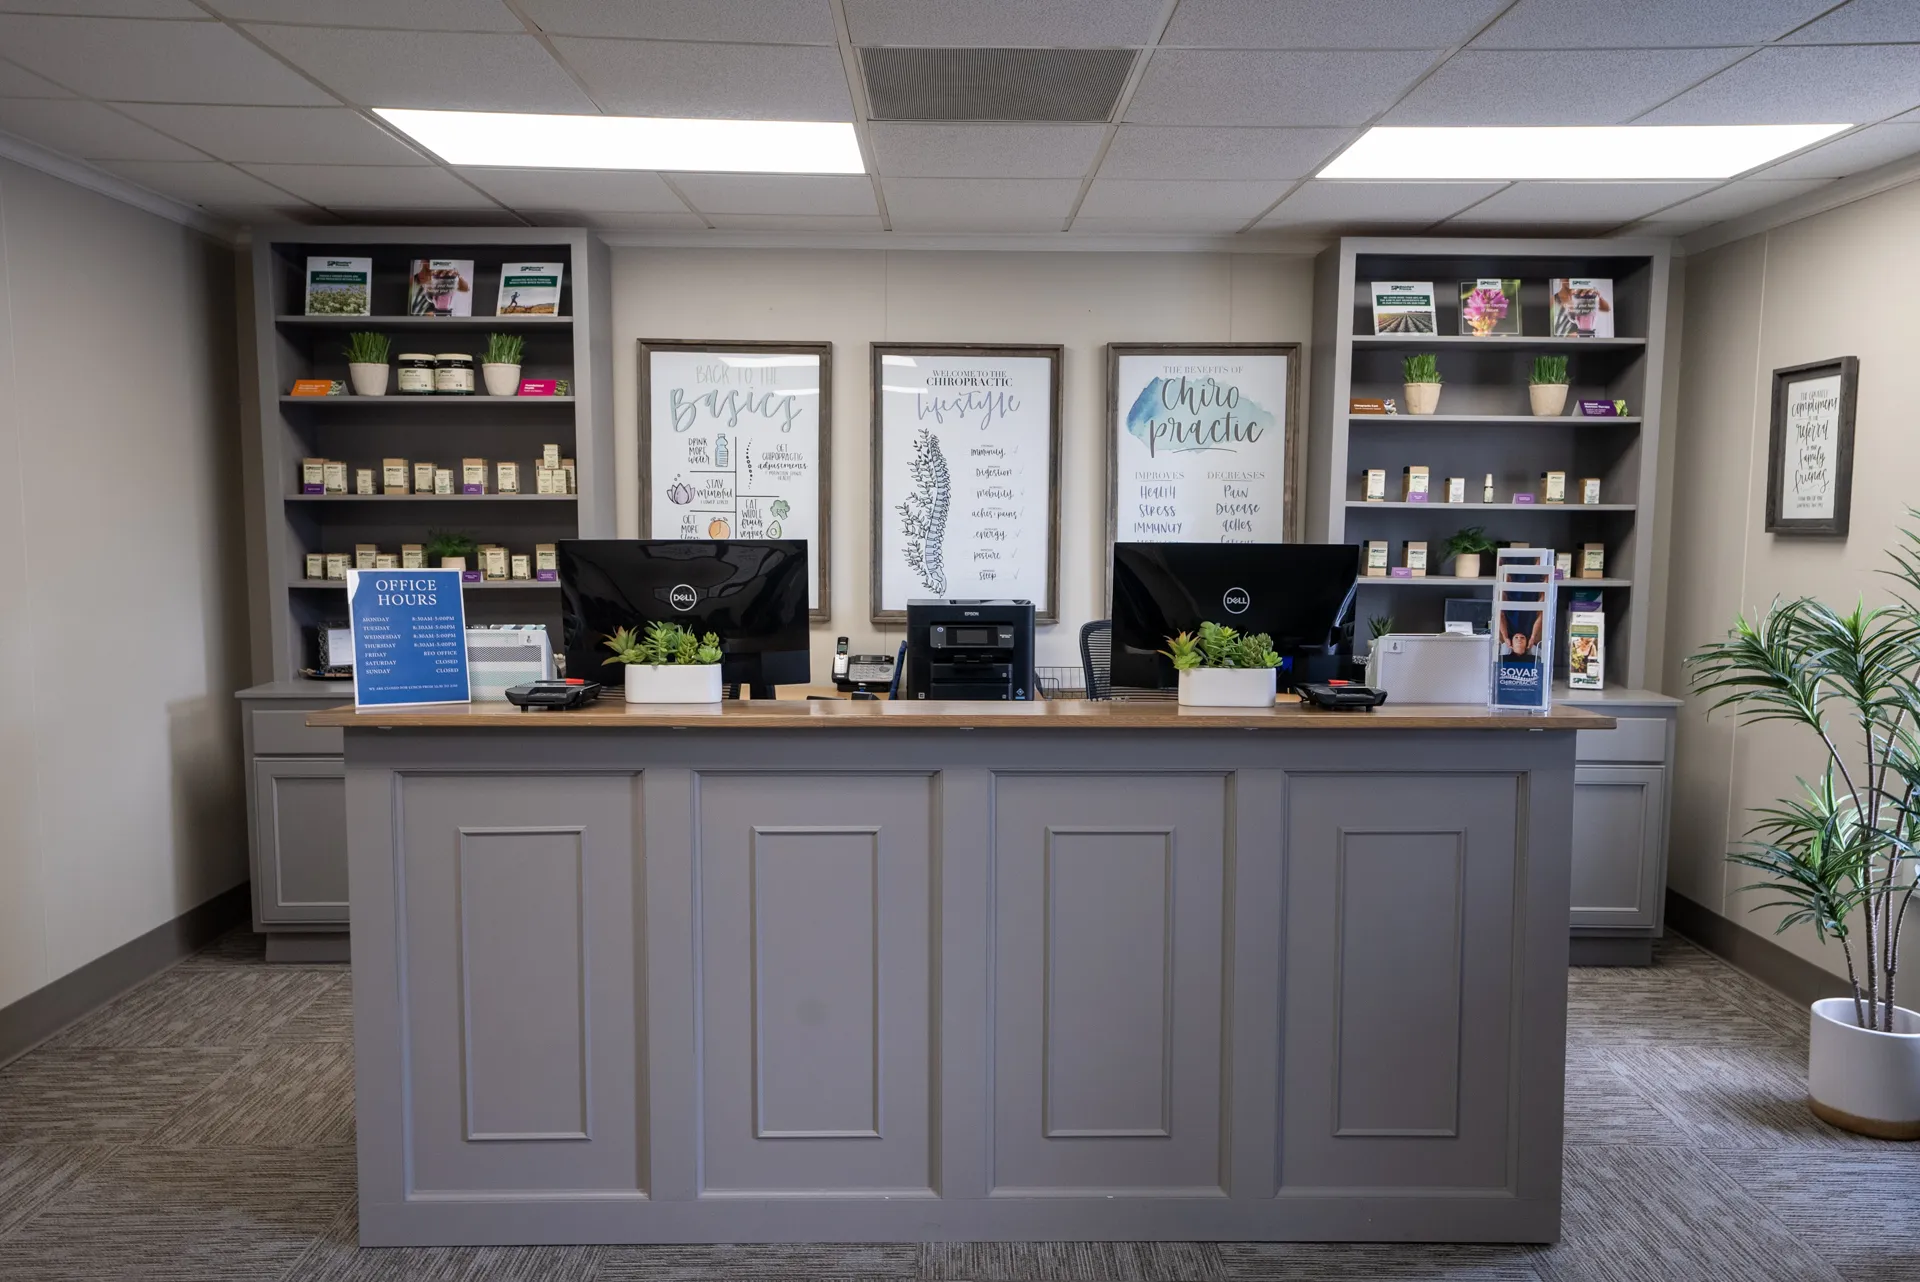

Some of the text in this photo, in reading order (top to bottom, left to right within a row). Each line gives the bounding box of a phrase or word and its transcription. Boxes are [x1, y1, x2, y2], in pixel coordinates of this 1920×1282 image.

[696, 365, 730, 384] BACK
[933, 370, 974, 378] WELCOME
[975, 370, 988, 378] TO
[1163, 366, 1244, 374] THE BENEFITS OF
[927, 377, 1013, 387] CHIROPRACTIC
[1162, 375, 1239, 416] Chiro
[670, 387, 803, 433] Basics
[918, 390, 1021, 431] lifestyle
[1149, 411, 1264, 458] practic
[689, 437, 708, 446] DRINK
[689, 446, 707, 456] MORE
[776, 444, 788, 453] GET
[1135, 471, 1185, 480] IMPROVES
[1207, 471, 1265, 480] DECREASES
[706, 479, 724, 489] STAY
[745, 499, 758, 509] EAT
[742, 509, 763, 519] WHOLE
[1216, 503, 1260, 516] Disease
[683, 515, 696, 524] GET
[681, 524, 698, 534] MORE
[376, 579, 437, 592] OFFICE
[378, 594, 437, 606] HOURS
[1501, 667, 1538, 677] SOVAR
